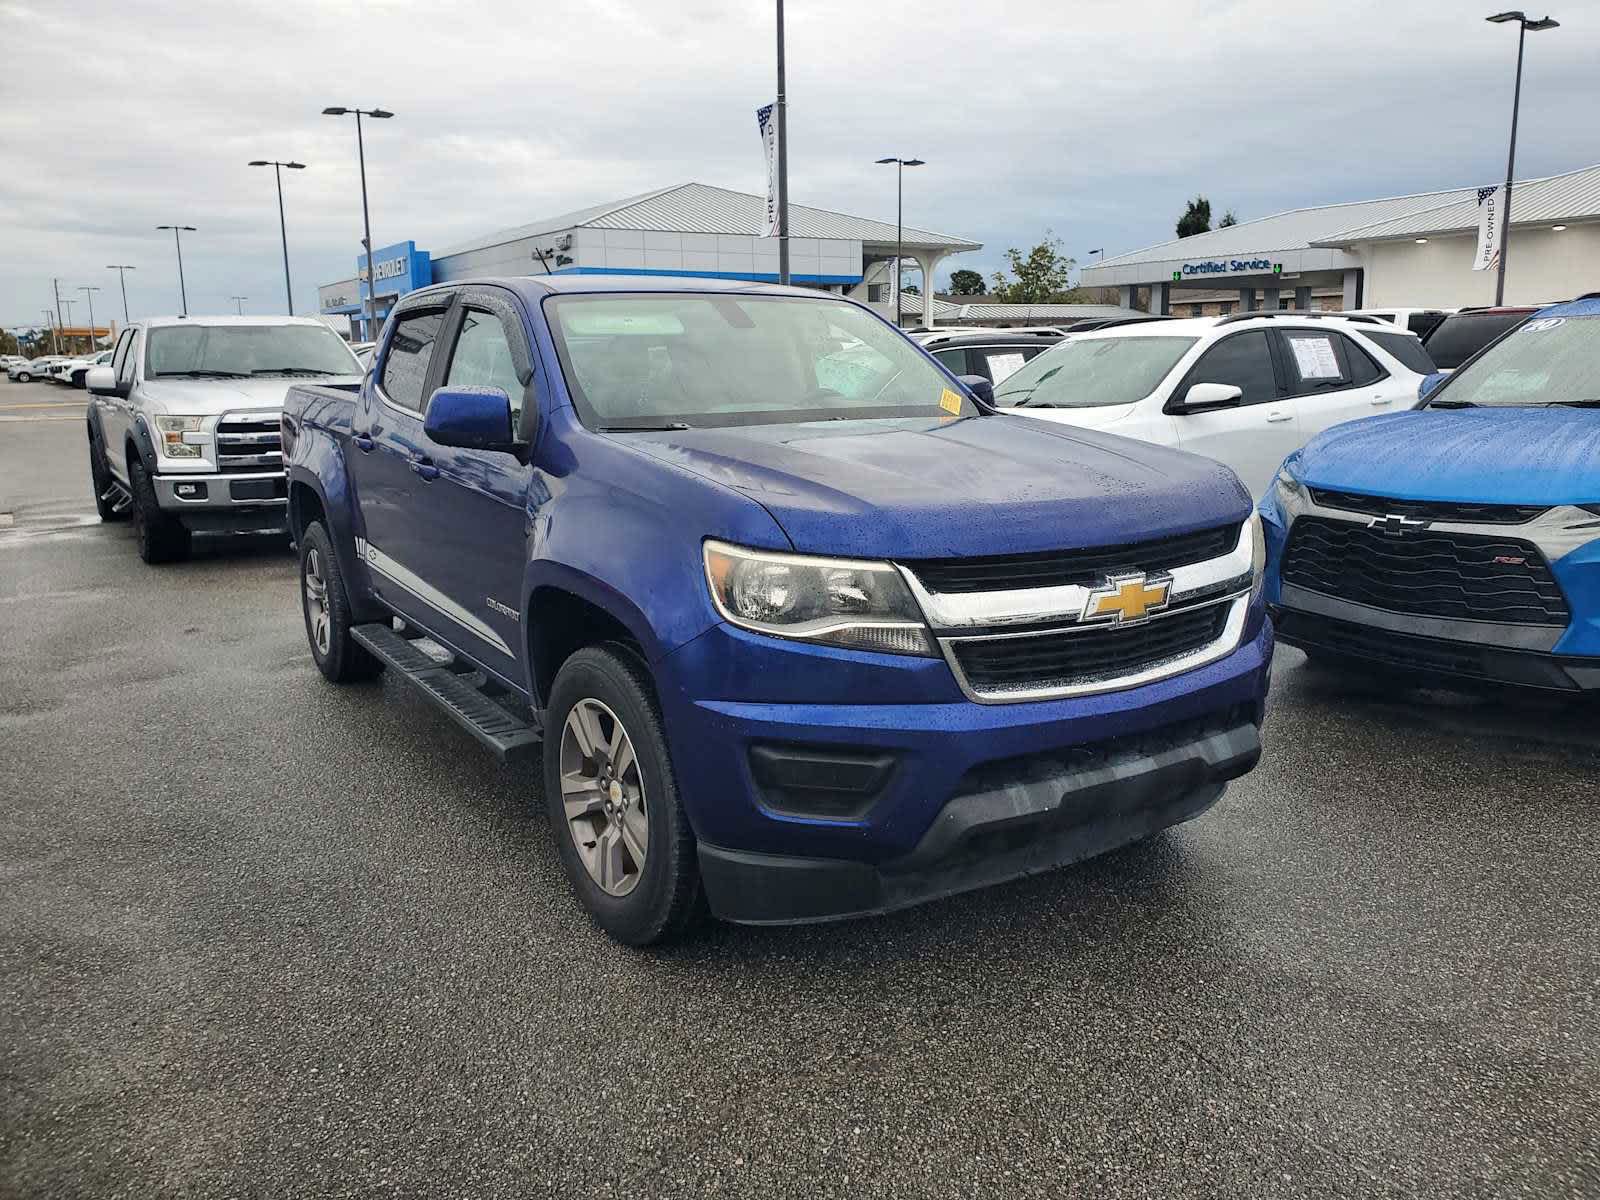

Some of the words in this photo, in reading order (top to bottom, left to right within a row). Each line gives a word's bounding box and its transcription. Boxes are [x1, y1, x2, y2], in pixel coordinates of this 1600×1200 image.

[1483, 198, 1495, 262] PRE-OWNED
[372, 257, 406, 279] HEVROLET
[1182, 261, 1226, 275] Certified
[1230, 258, 1271, 272] Service
